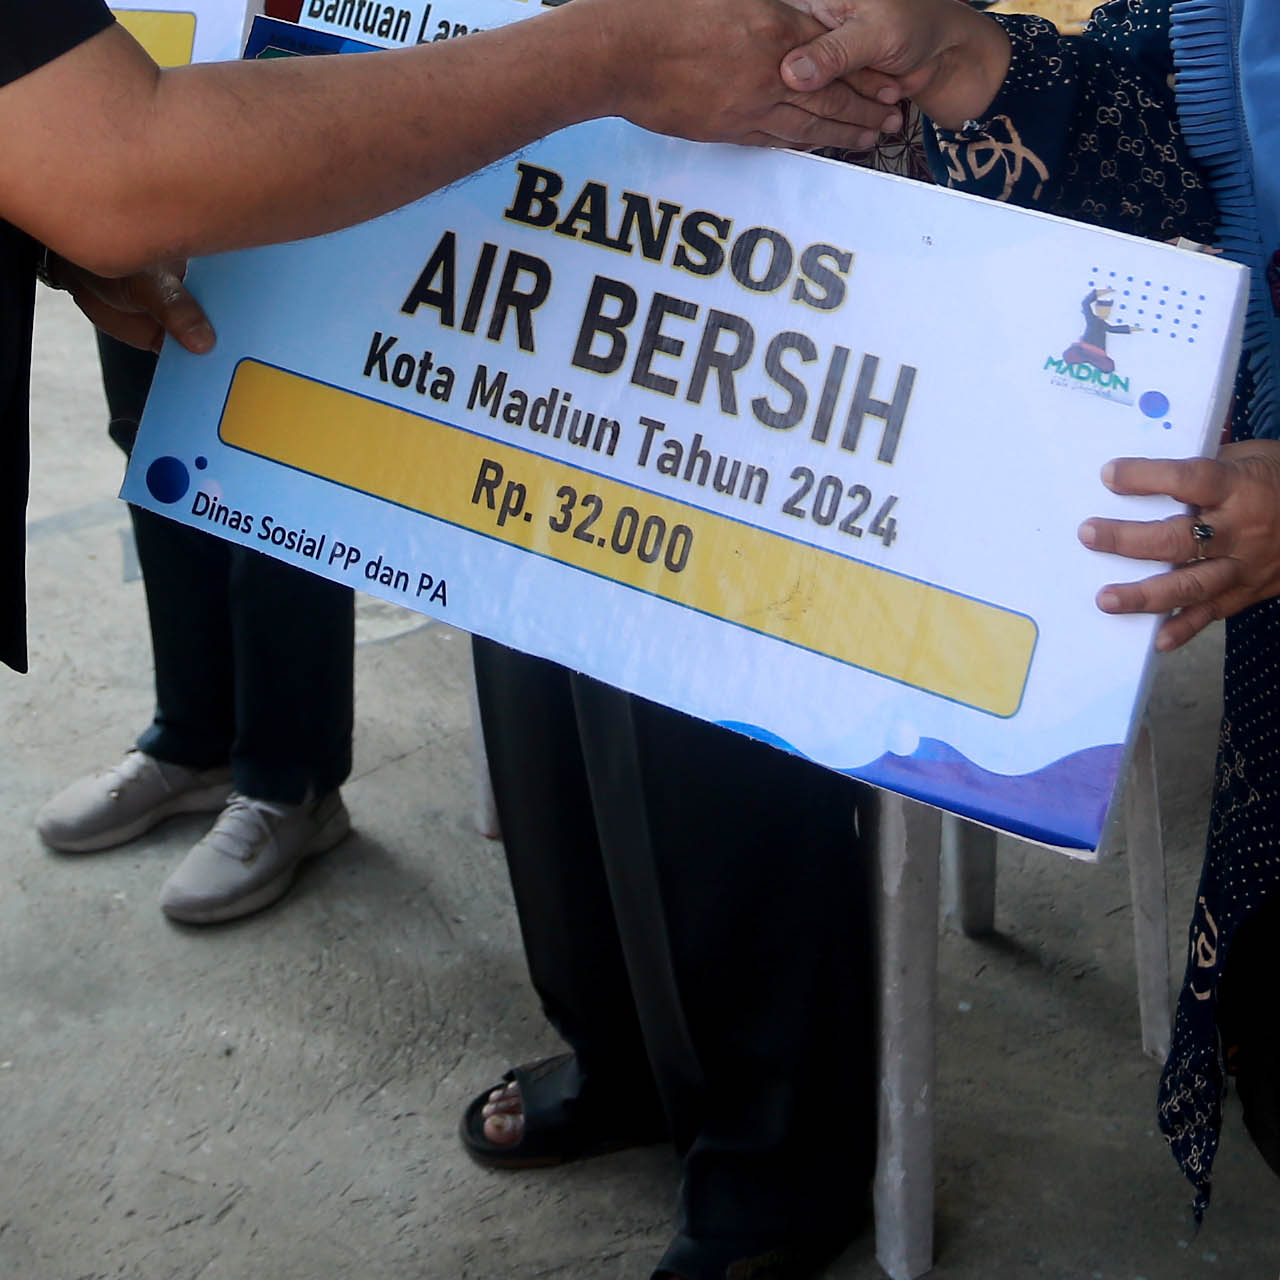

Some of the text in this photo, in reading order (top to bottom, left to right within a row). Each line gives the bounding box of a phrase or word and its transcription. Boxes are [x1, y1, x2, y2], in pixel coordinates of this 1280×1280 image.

[504, 162, 855, 312] BANSOS
[400, 231, 918, 465] AIR BERSIH
[362, 330, 899, 547] Kota Madiun Tahun 2024
[191, 491, 448, 607] Dinas Sosial PP dan PA
[472, 458, 693, 573] Rp. 32.000
